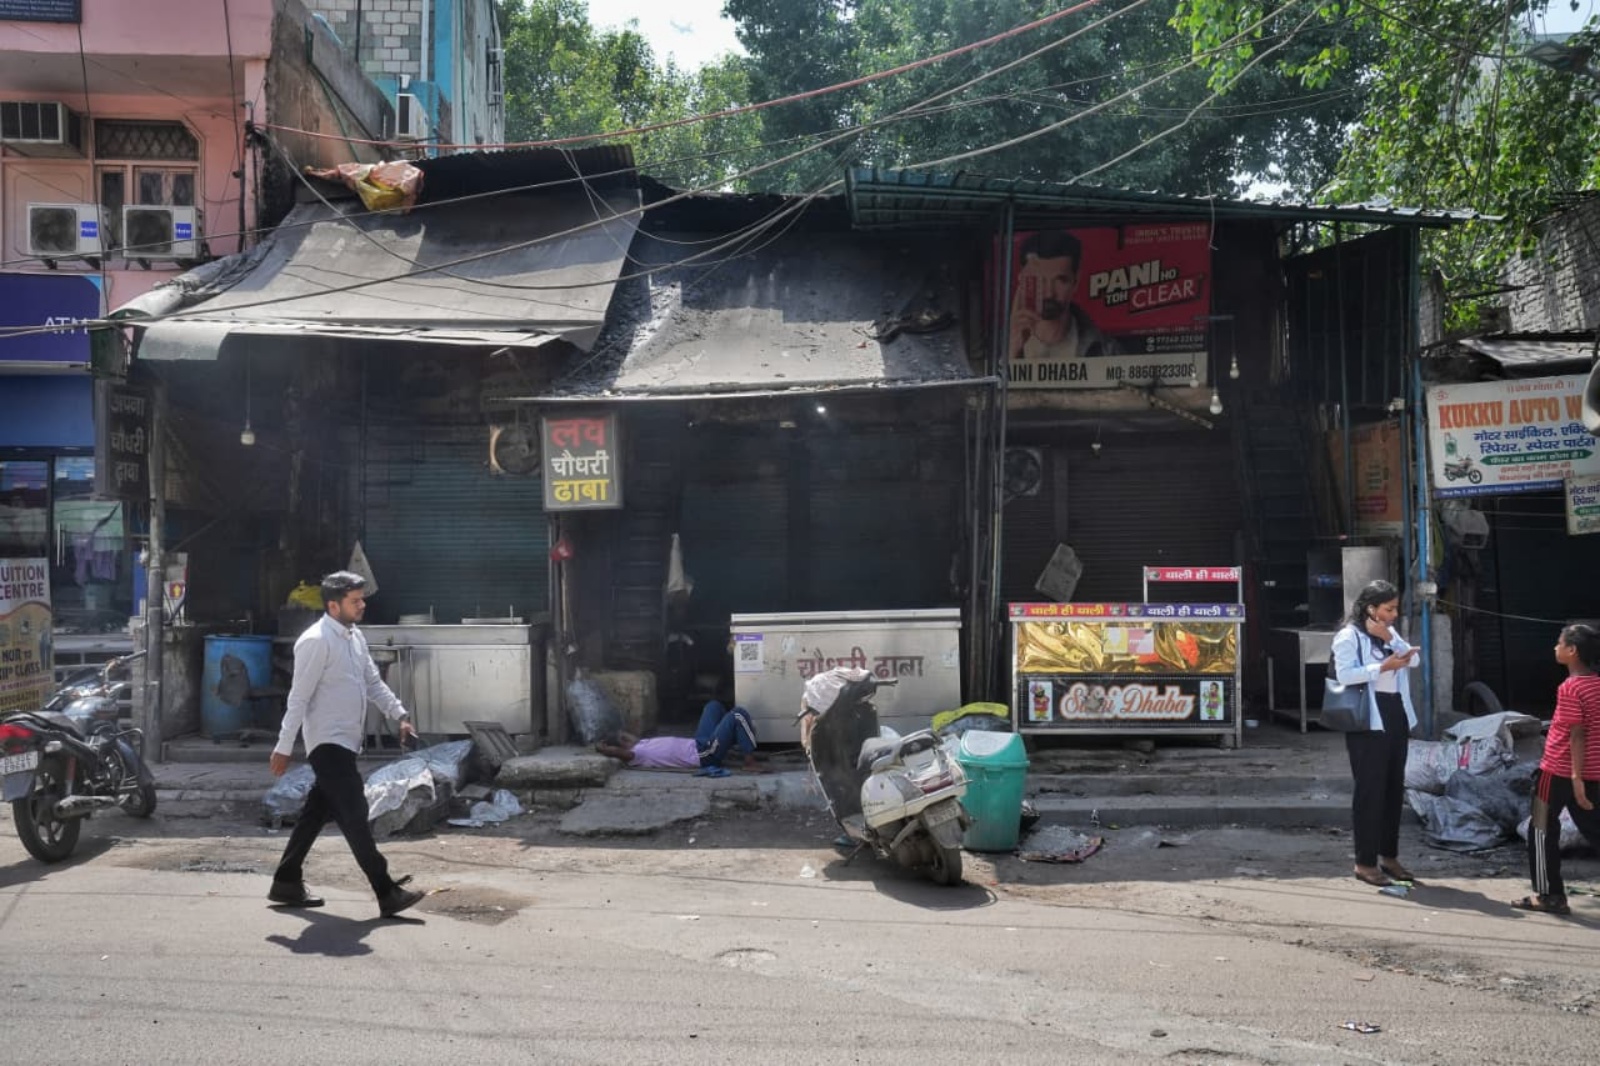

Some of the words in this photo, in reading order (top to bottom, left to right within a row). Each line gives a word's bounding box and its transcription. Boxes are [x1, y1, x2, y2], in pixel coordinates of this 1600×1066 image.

[1089, 260, 1161, 297] PANI
[1161, 269, 1177, 280] HO
[1106, 291, 1128, 304] TOH
[1132, 279, 1195, 308] CLEAR
[45, 316, 89, 335] ATM
[1038, 362, 1087, 381] DHABA
[1439, 401, 1503, 429] KUKKU
[1509, 396, 1560, 424] AUTO
[547, 418, 607, 447] लव
[1473, 430, 1501, 441] मोटर
[1526, 439, 1560, 451] स्पेयर
[551, 449, 609, 476] चौधरी
[551, 479, 610, 501] ढाबा
[15, 660, 40, 677] CLASS
[873, 655, 925, 678] ढाबा
[1120, 687, 1187, 714] Dhaba
